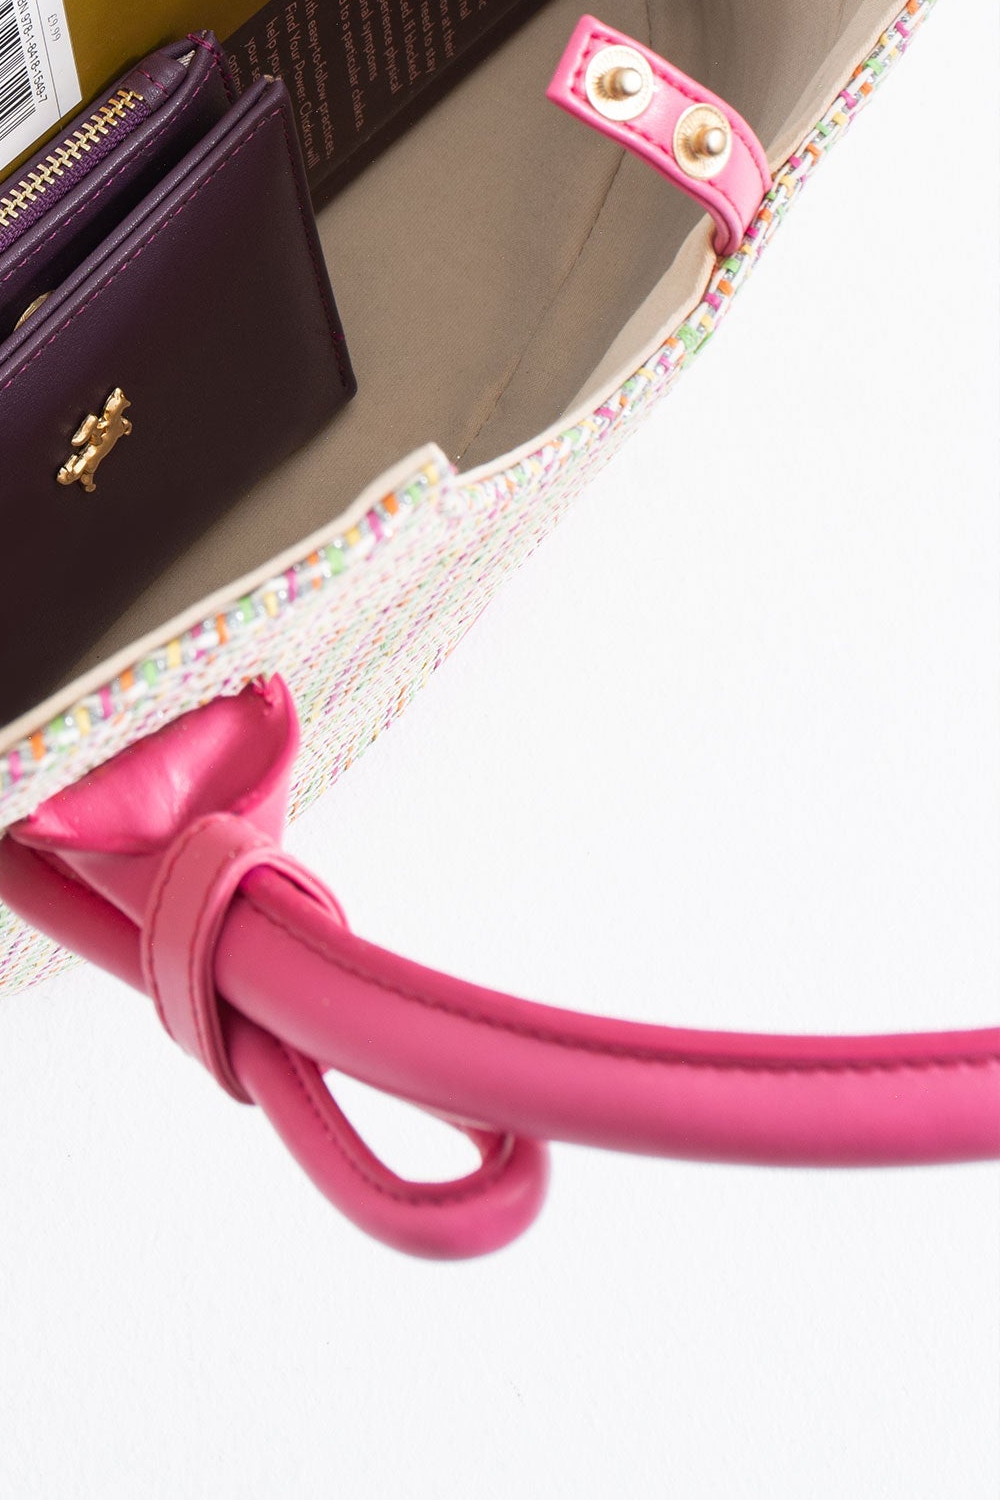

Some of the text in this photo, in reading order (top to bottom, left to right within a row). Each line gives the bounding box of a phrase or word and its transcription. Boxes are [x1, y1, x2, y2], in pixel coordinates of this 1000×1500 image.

[47, 13, 62, 42] £9.99
[339, 3, 350, 21] to
[341, 20, 351, 31] a
[403, 18, 416, 33] If
[420, 0, 435, 33] need
[441, 16, 452, 31] at
[265, 16, 280, 49] help
[423, 30, 433, 47] to
[443, 28, 456, 58] their
[20, 12, 48, 103] 978-1-8418-1549-7
[244, 36, 261, 83] your se
[307, 19, 328, 100] easy-to-follow
[341, 30, 361, 87] particular
[361, 21, 378, 81] symptoms
[425, 47, 436, 74] stay
[284, 1, 321, 169] Find Your Power: Chakra will
[383, 46, 403, 94] physical
[351, 88, 366, 132] chakra.
